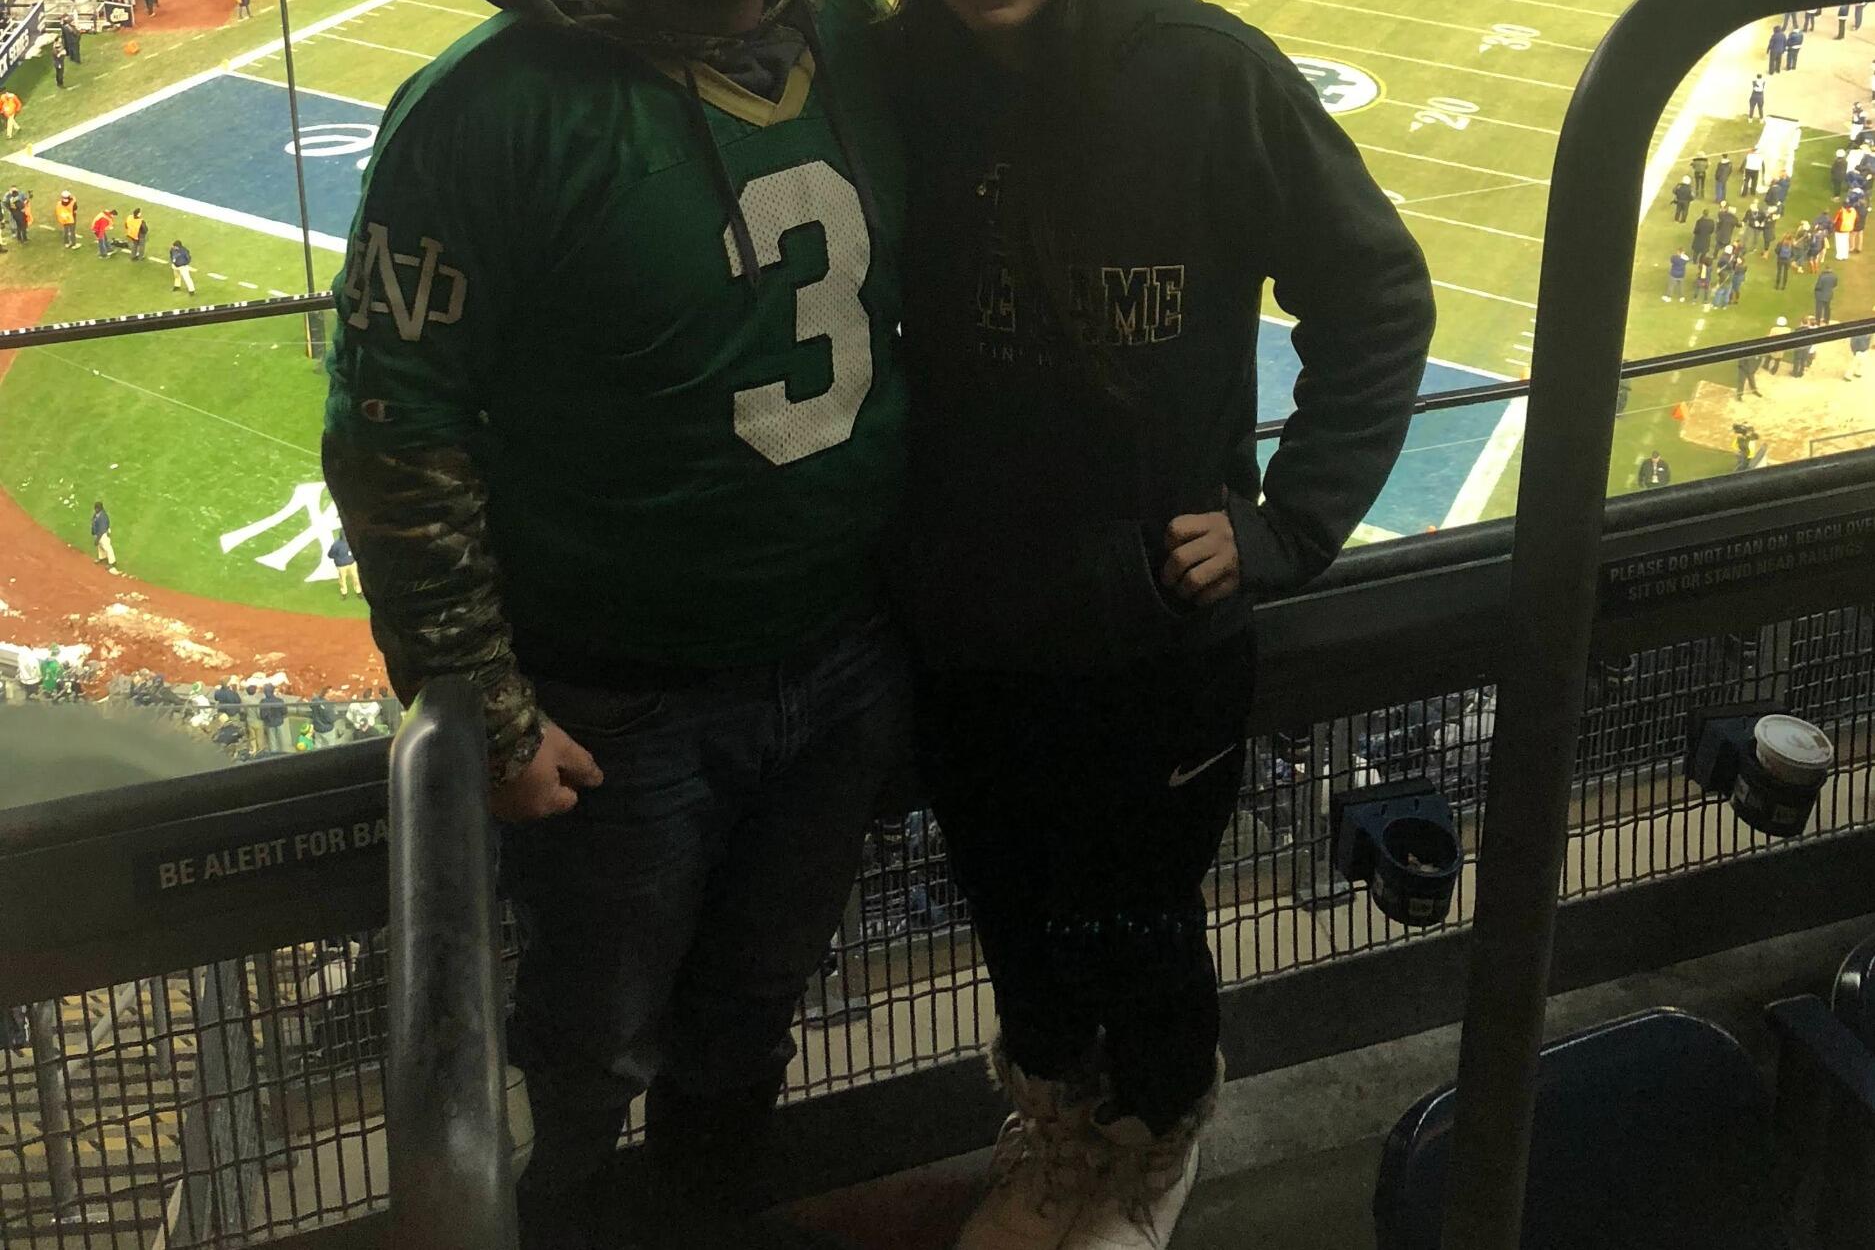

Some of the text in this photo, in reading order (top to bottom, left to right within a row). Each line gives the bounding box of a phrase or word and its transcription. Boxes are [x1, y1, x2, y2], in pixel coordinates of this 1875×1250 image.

[723, 159, 874, 466] 3
[1610, 558, 1664, 583] PLEASE
[1668, 553, 1689, 571] DO
[1693, 546, 1723, 567] NOT
[1846, 518, 1875, 536] OVE
[158, 858, 196, 889] BE
[203, 839, 287, 880] ALERT
[295, 827, 347, 860] FOR
